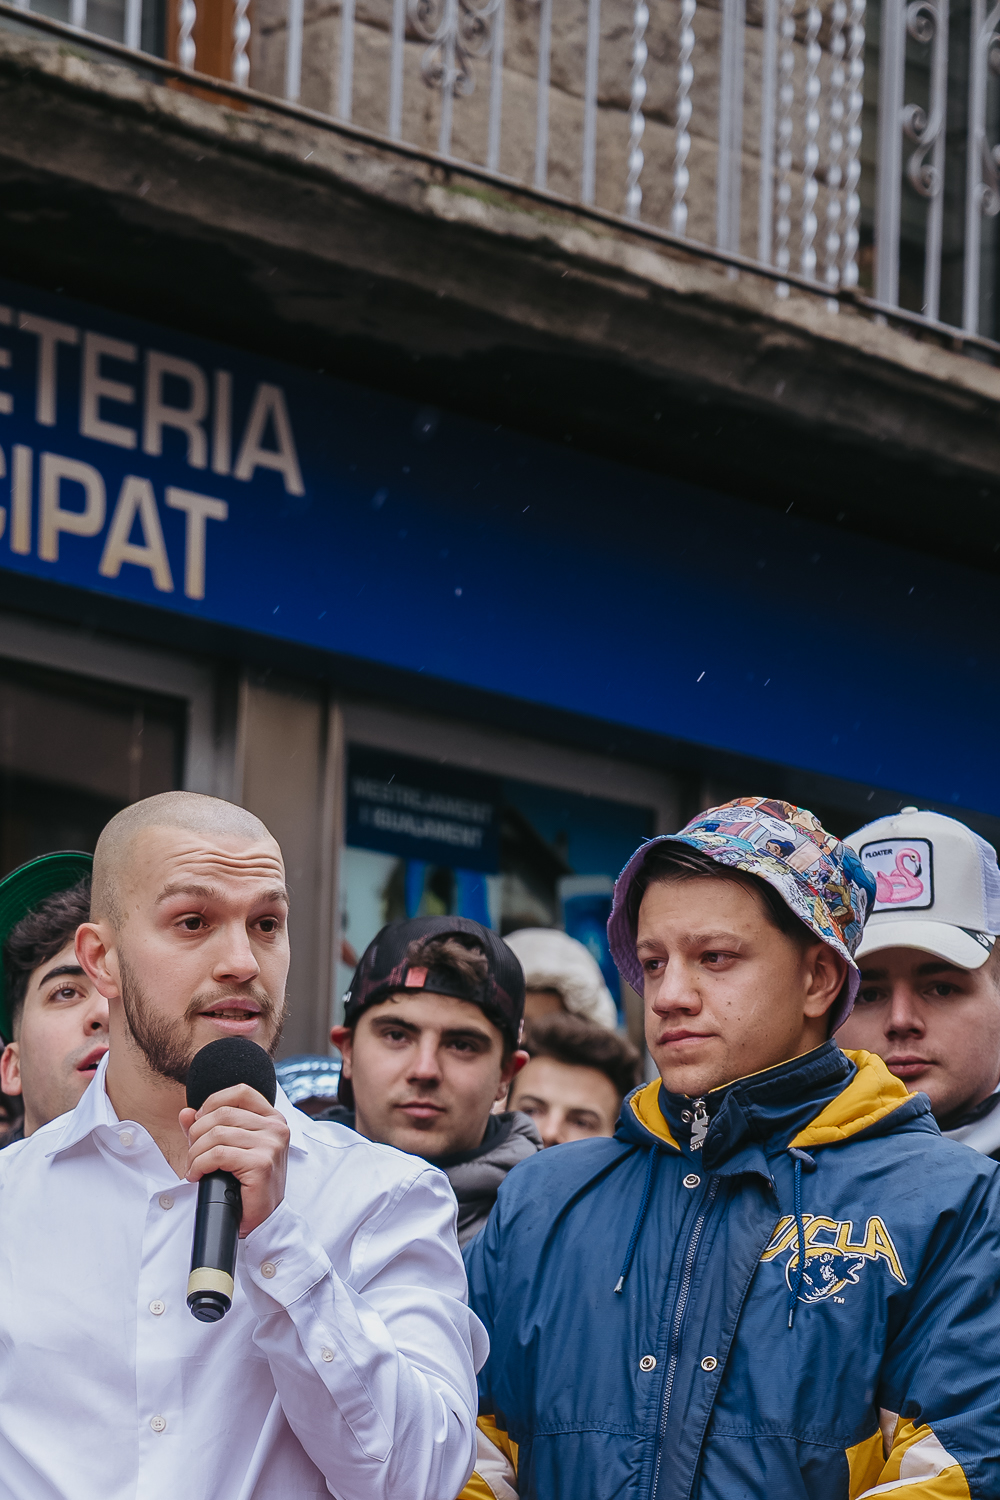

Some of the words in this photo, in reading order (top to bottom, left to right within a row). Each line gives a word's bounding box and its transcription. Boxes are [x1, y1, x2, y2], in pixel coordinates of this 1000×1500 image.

[865, 848, 893, 859] FLOATER
[760, 1213, 908, 1286] UCLA
[833, 1296, 845, 1304] TM
